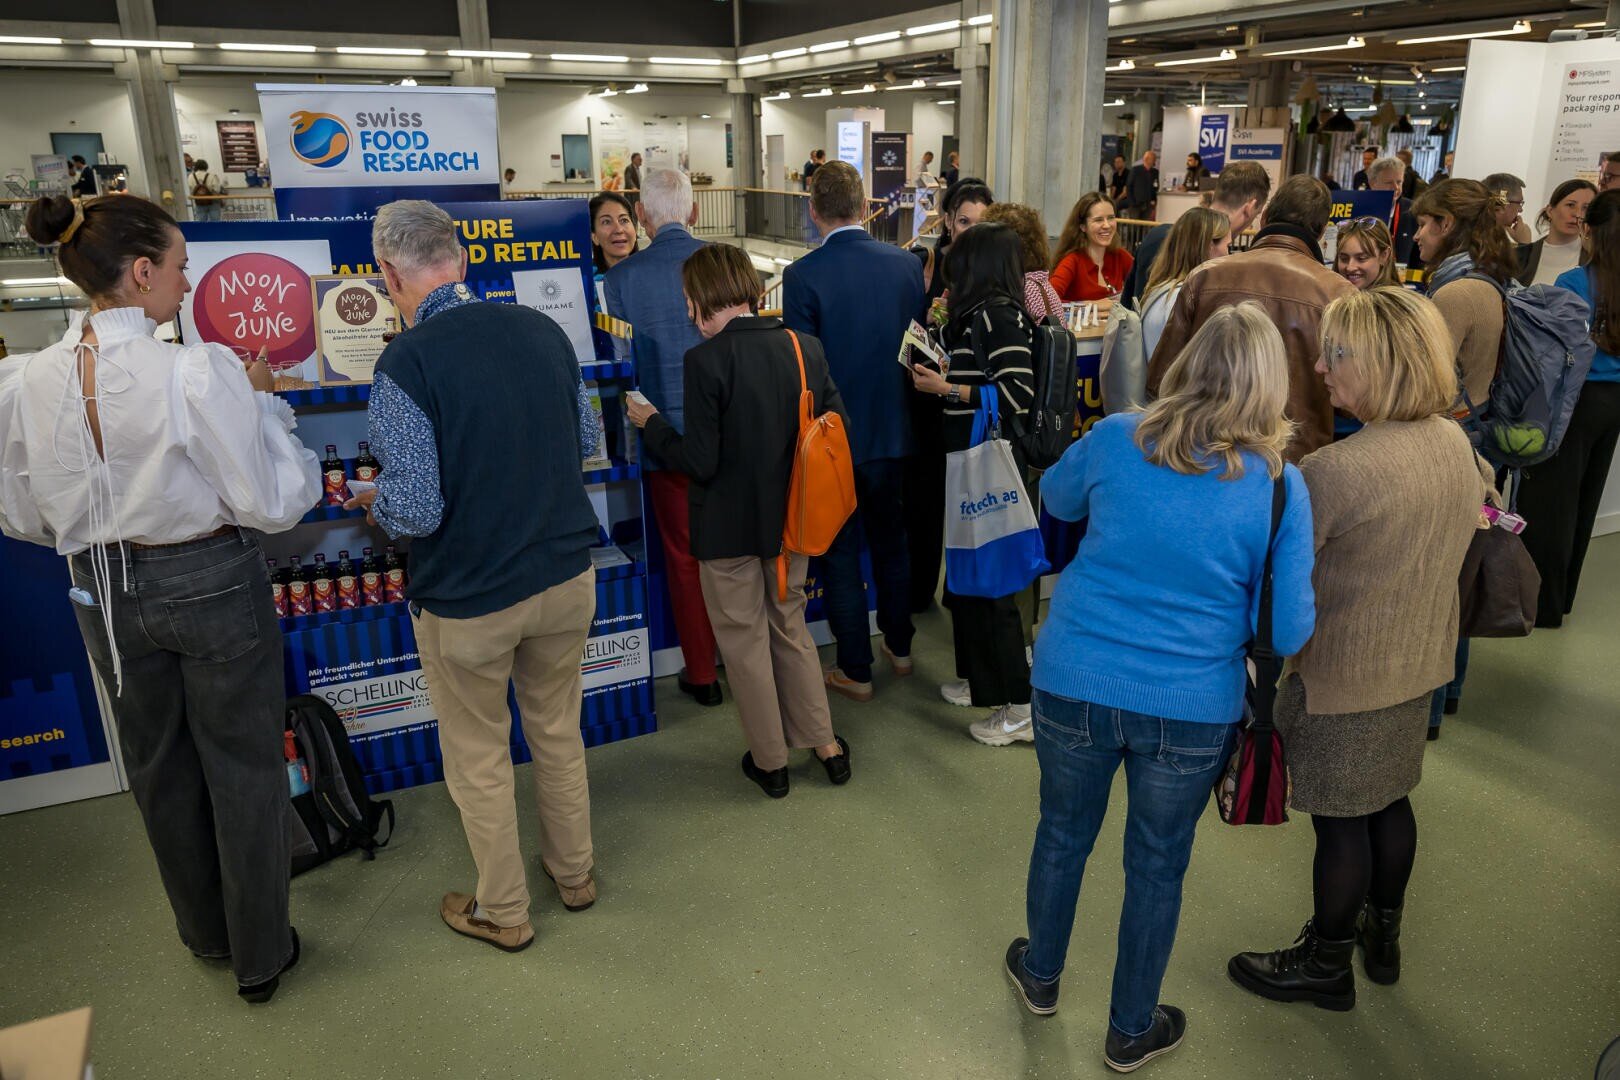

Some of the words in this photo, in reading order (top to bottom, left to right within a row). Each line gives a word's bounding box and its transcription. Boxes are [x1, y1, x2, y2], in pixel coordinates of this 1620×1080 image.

[1565, 94, 1586, 102] Your
[356, 107, 423, 128] swiss
[1563, 103, 1611, 114] packaging
[1613, 104, 1620, 112] p
[360, 130, 429, 151] FOOD
[1200, 128, 1225, 148] SVI
[363, 151, 479, 173] RESEARCH
[493, 240, 581, 263] RETAIL
[485, 289, 516, 300] power
[252, 296, 268, 313] &
[1002, 490, 1019, 504] ag
[308, 668, 323, 677] Mit
[324, 660, 375, 674] freundlicher
[377, 652, 420, 665] Unterstütz
[309, 673, 348, 686] gedruckt
[349, 670, 369, 678] von:
[325, 674, 429, 707] SCHELLING
[344, 721, 366, 731] ahre
